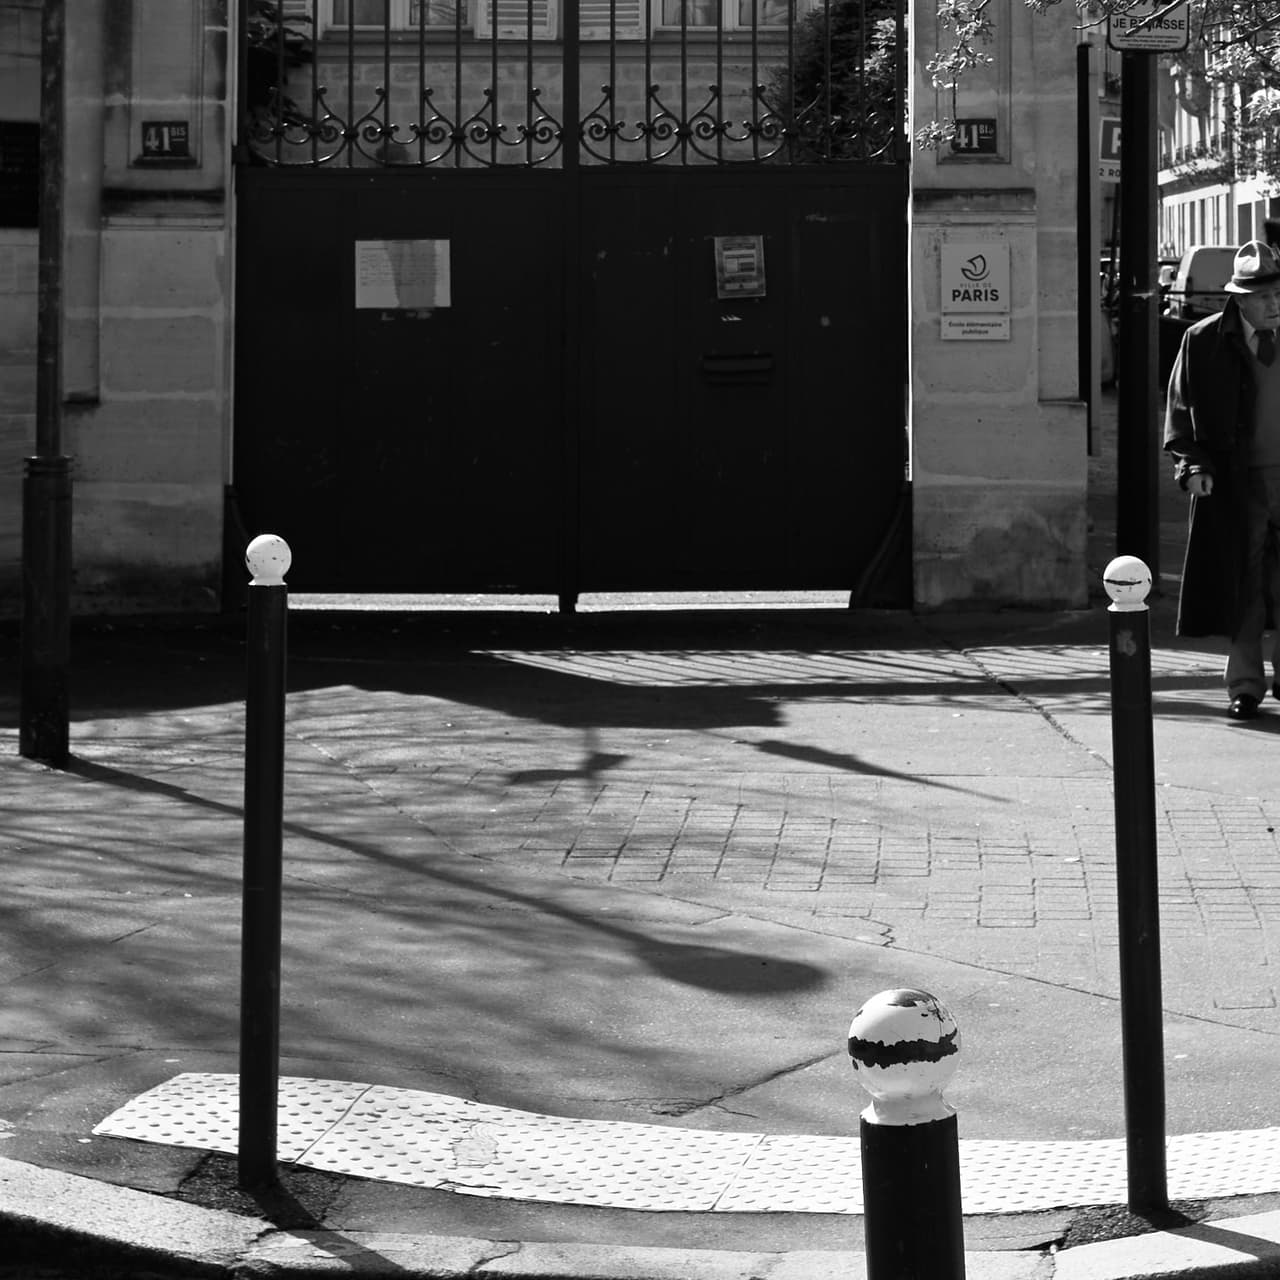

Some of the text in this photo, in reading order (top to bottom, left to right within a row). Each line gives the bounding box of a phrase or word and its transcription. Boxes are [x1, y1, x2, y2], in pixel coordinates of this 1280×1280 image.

[1113, 18, 1127, 29] JE
[145, 127, 171, 151] 41
[955, 124, 980, 148] 41
[952, 289, 999, 302] PARIS
